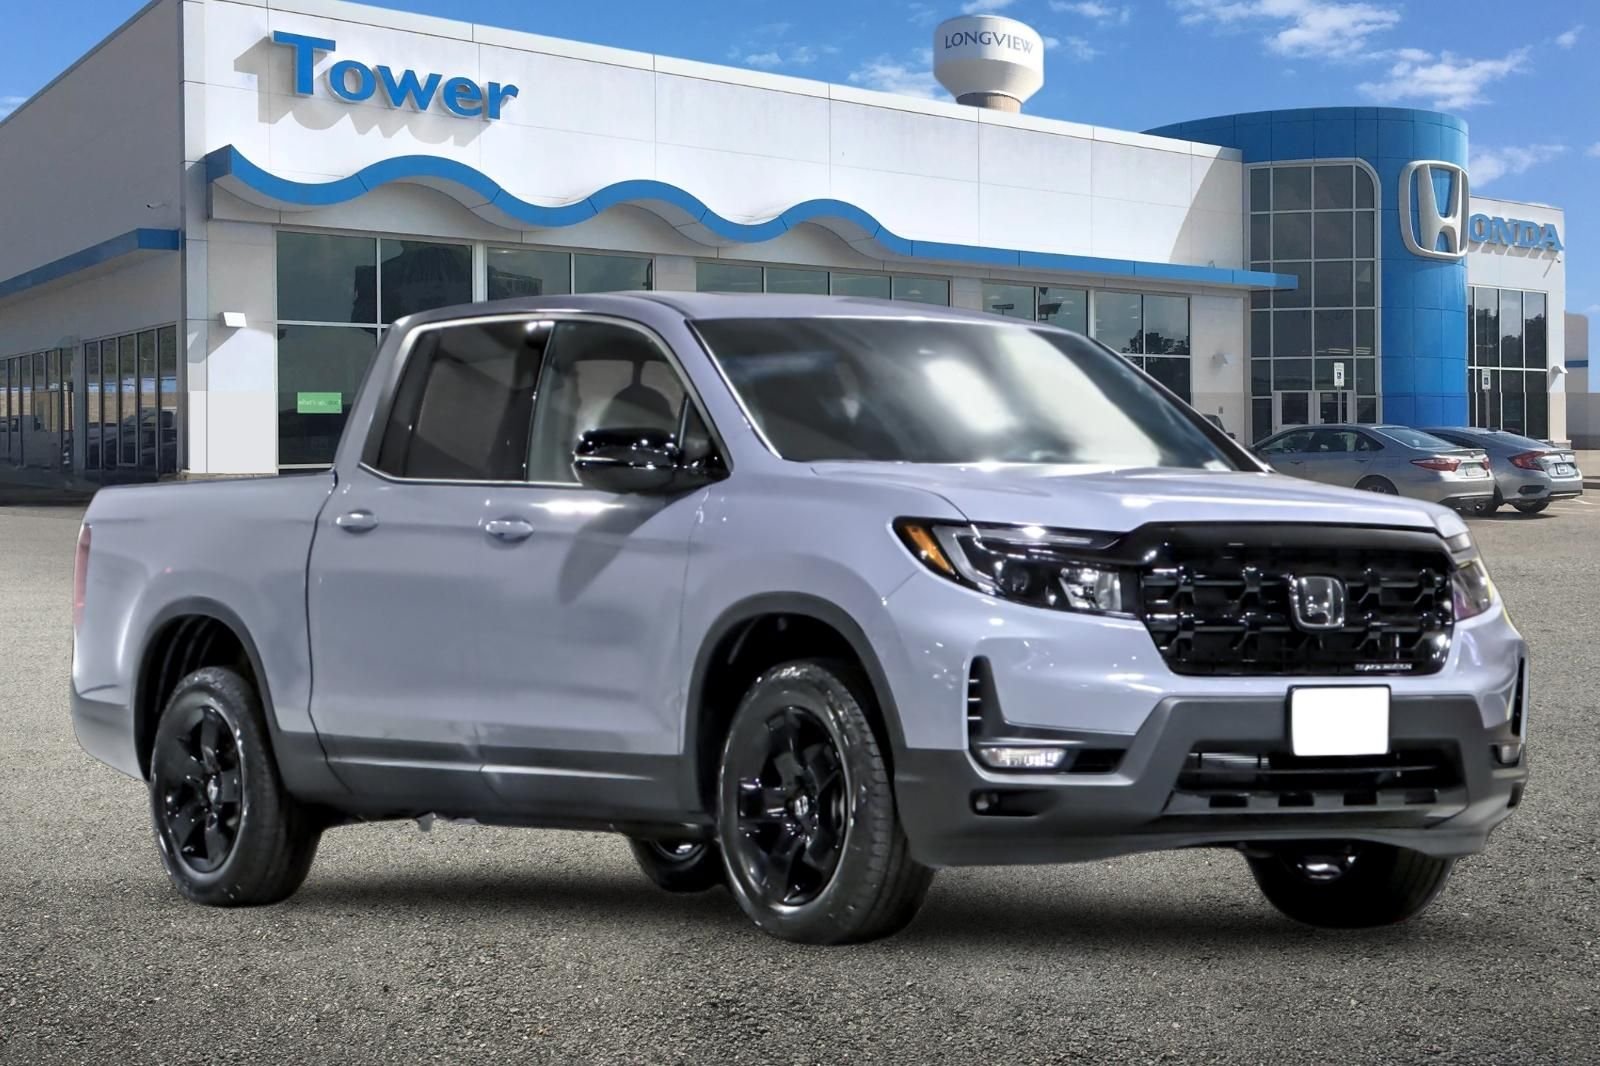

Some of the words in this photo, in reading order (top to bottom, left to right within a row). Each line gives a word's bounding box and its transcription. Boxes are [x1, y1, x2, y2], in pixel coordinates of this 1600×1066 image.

[945, 31, 1034, 54] LONGVIEW
[272, 30, 520, 120] Tower
[1470, 213, 1565, 250] ONDA
